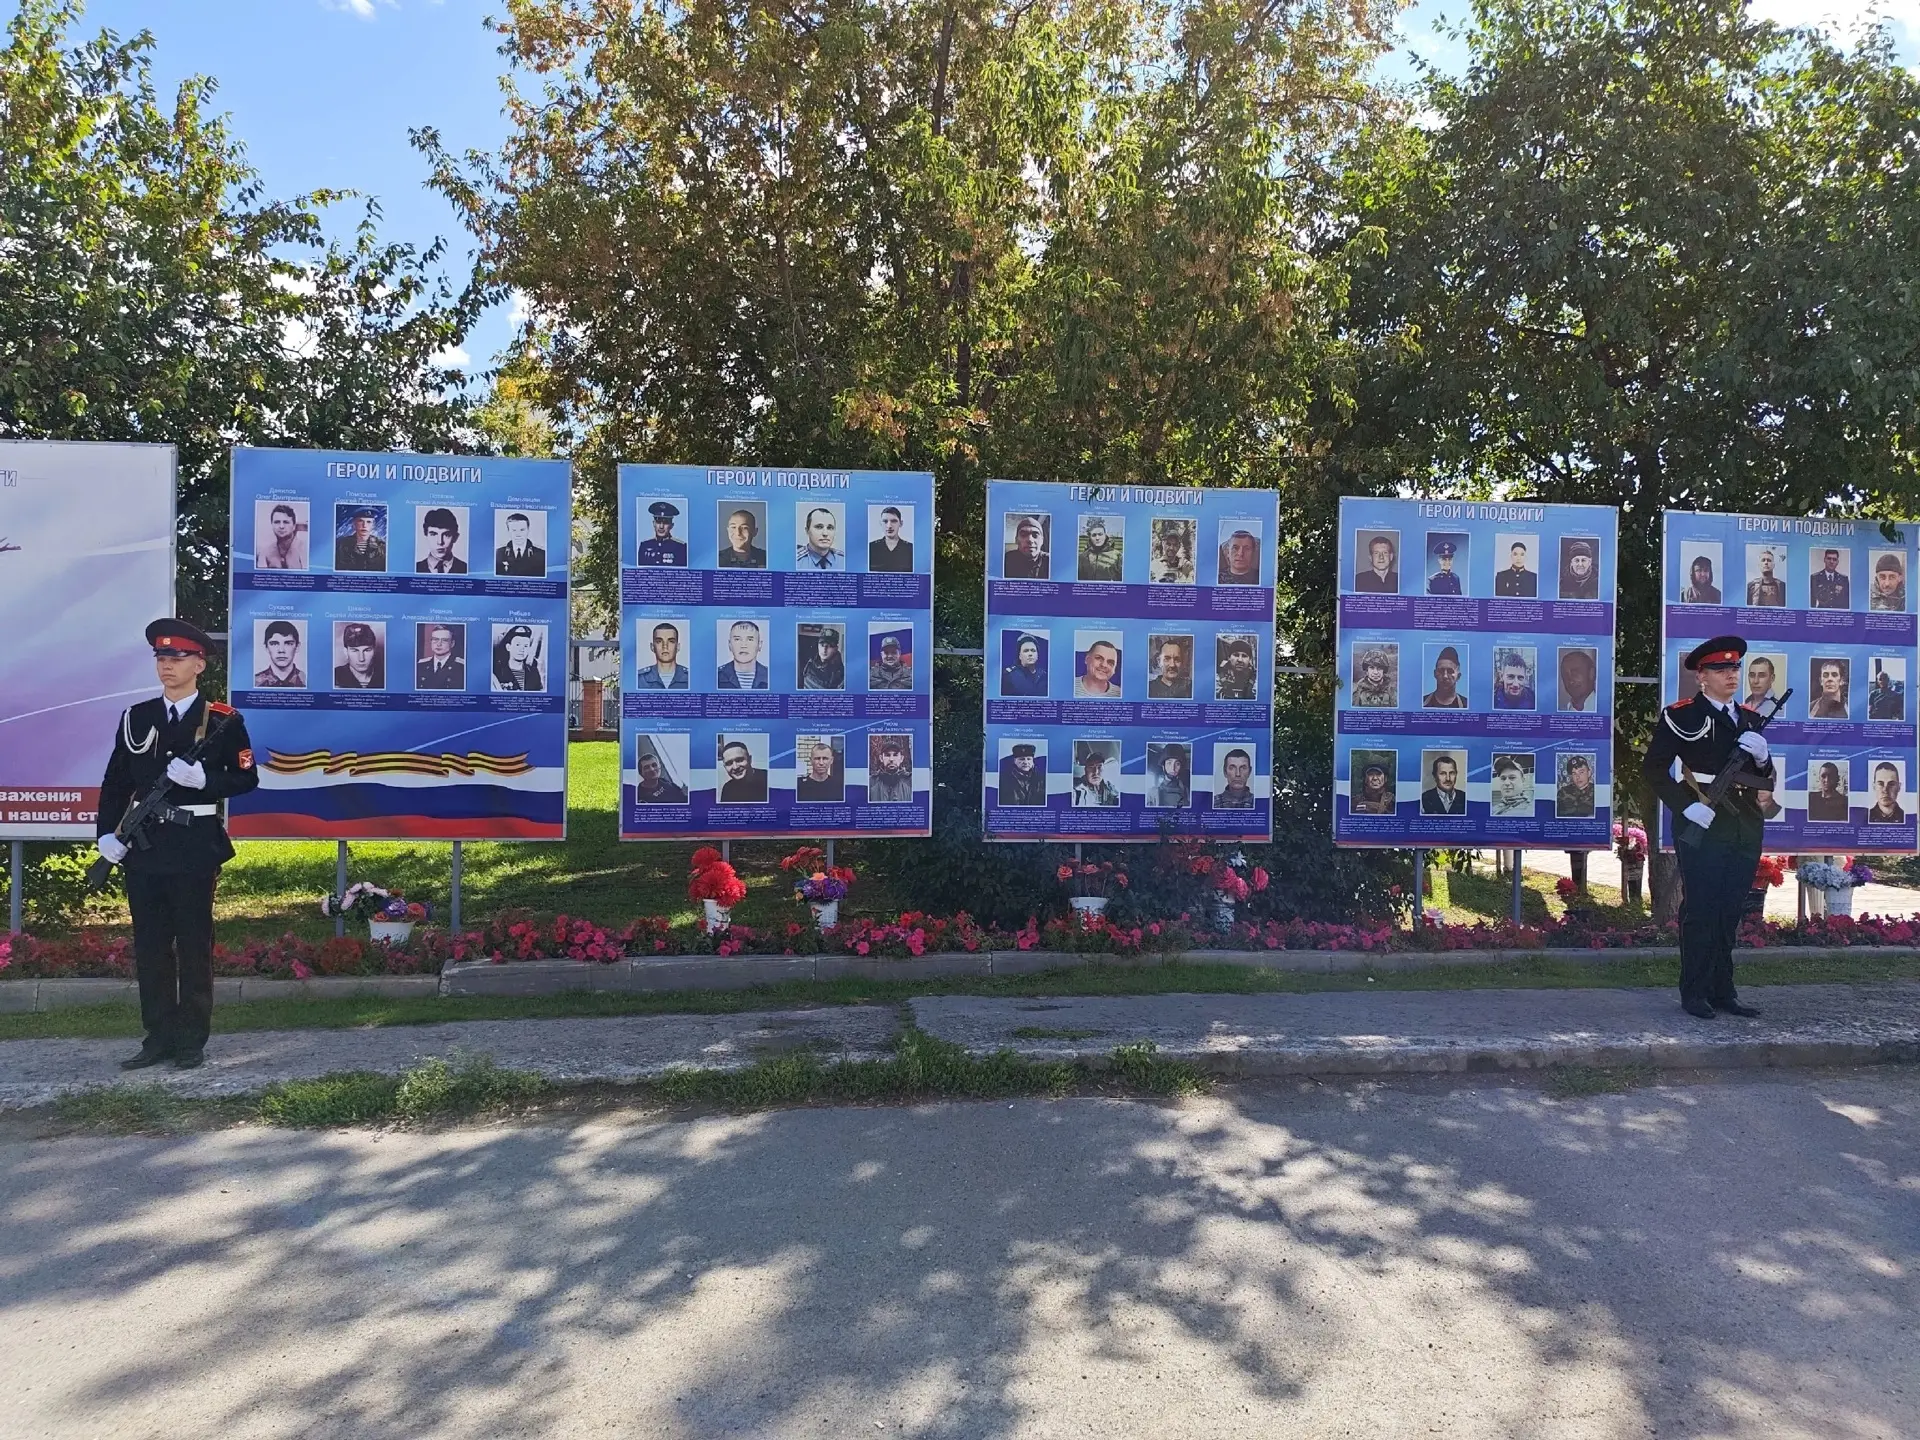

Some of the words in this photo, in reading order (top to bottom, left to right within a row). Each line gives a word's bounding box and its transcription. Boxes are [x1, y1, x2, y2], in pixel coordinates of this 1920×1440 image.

[326, 462, 380, 479] ГЕРОИ
[385, 464, 398, 480] И
[402, 465, 483, 484] ПОДВИГИ
[707, 470, 758, 487] ГЕРОИ
[761, 471, 773, 487] И
[777, 471, 851, 489] ПОДВИГИ
[1120, 488, 1130, 503] И
[1133, 488, 1204, 506] ПОДВИГИ
[1417, 503, 1461, 519] ГЕРОИ
[1465, 505, 1475, 519] И
[1479, 505, 1545, 523] ПОДВИГИ
[1737, 517, 1779, 532] ГЕРОИ
[1782, 519, 1792, 533] И
[1794, 519, 1855, 536] ПОДВИГИ
[8, 807, 72, 822] нашей
